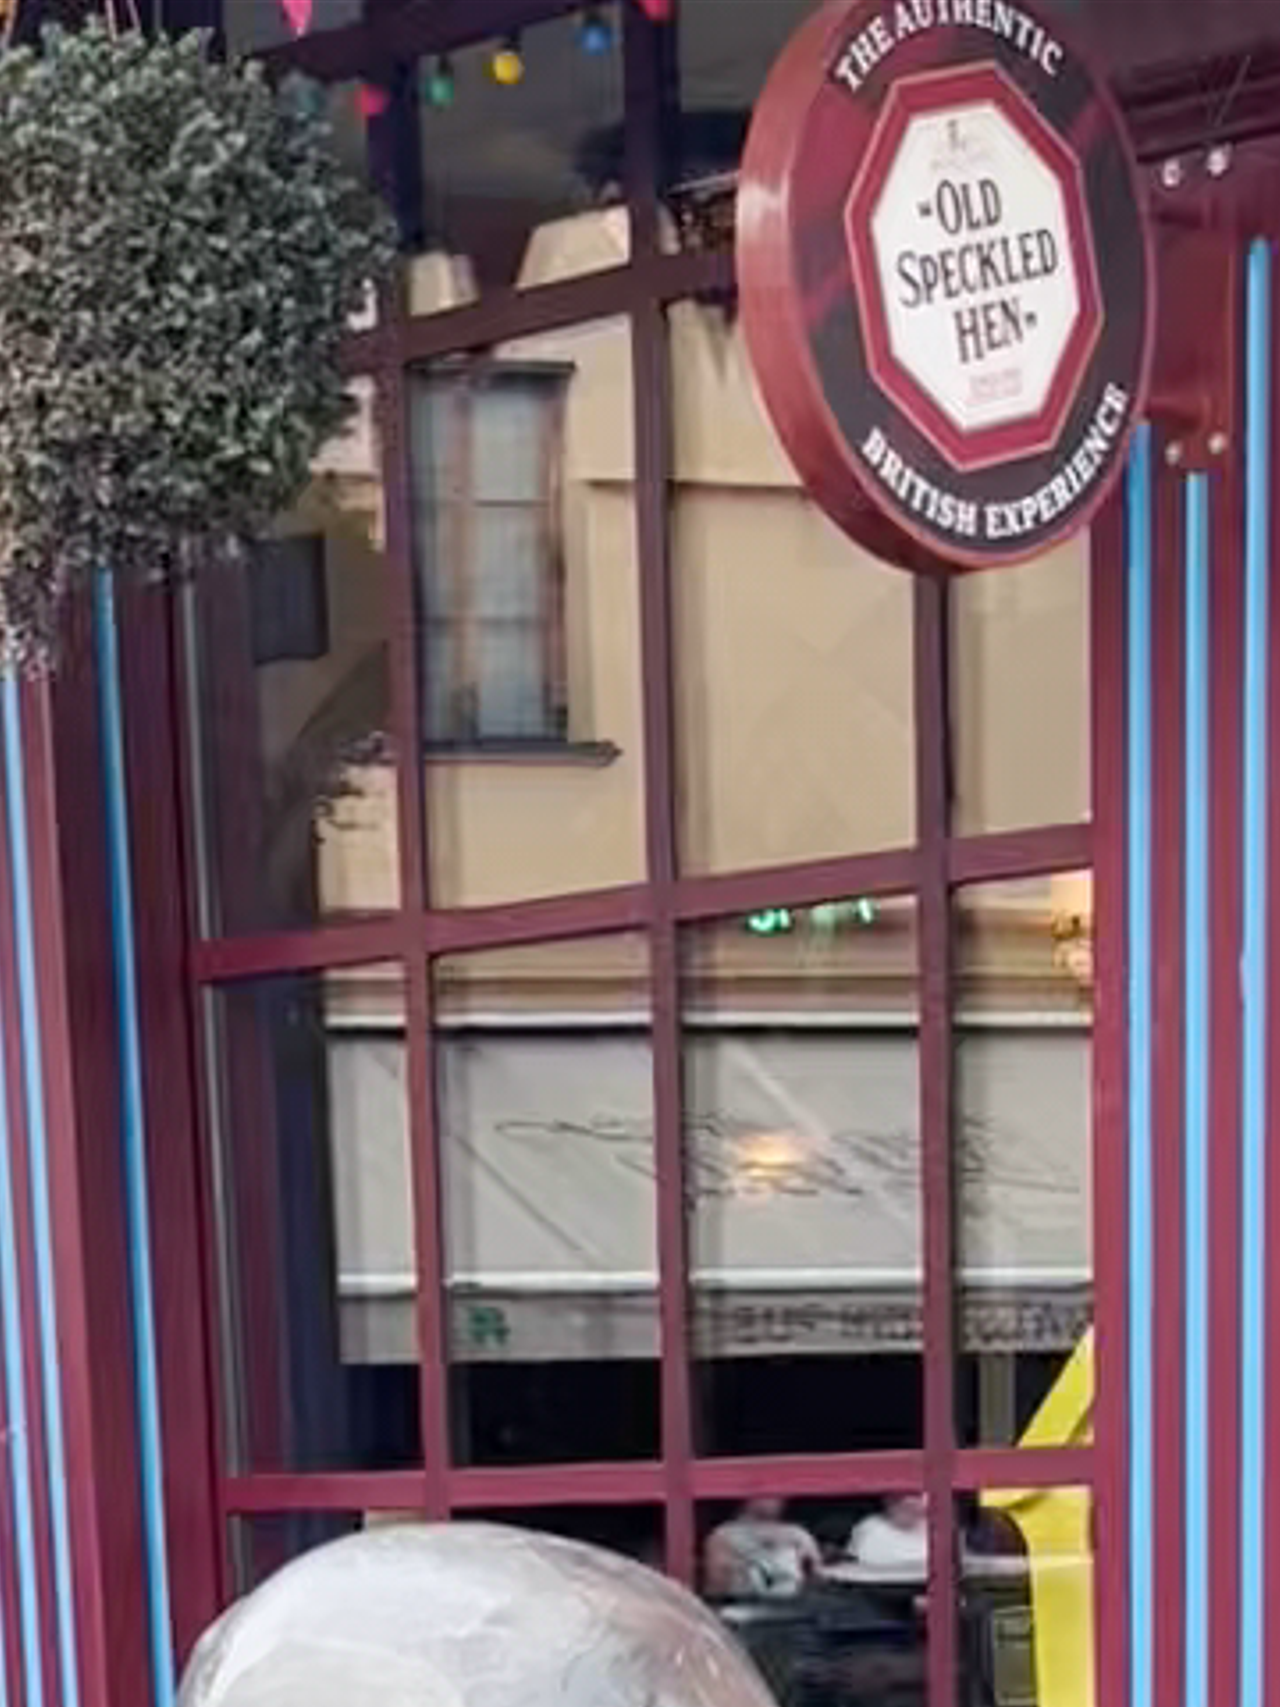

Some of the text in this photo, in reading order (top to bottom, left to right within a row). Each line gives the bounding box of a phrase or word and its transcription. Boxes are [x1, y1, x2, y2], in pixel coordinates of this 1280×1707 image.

[835, 0, 1064, 91] THE AUTHENTIC
[897, 229, 1058, 309] SPECKLED
[862, 383, 1129, 540] BRITISH EXPERIENCE
